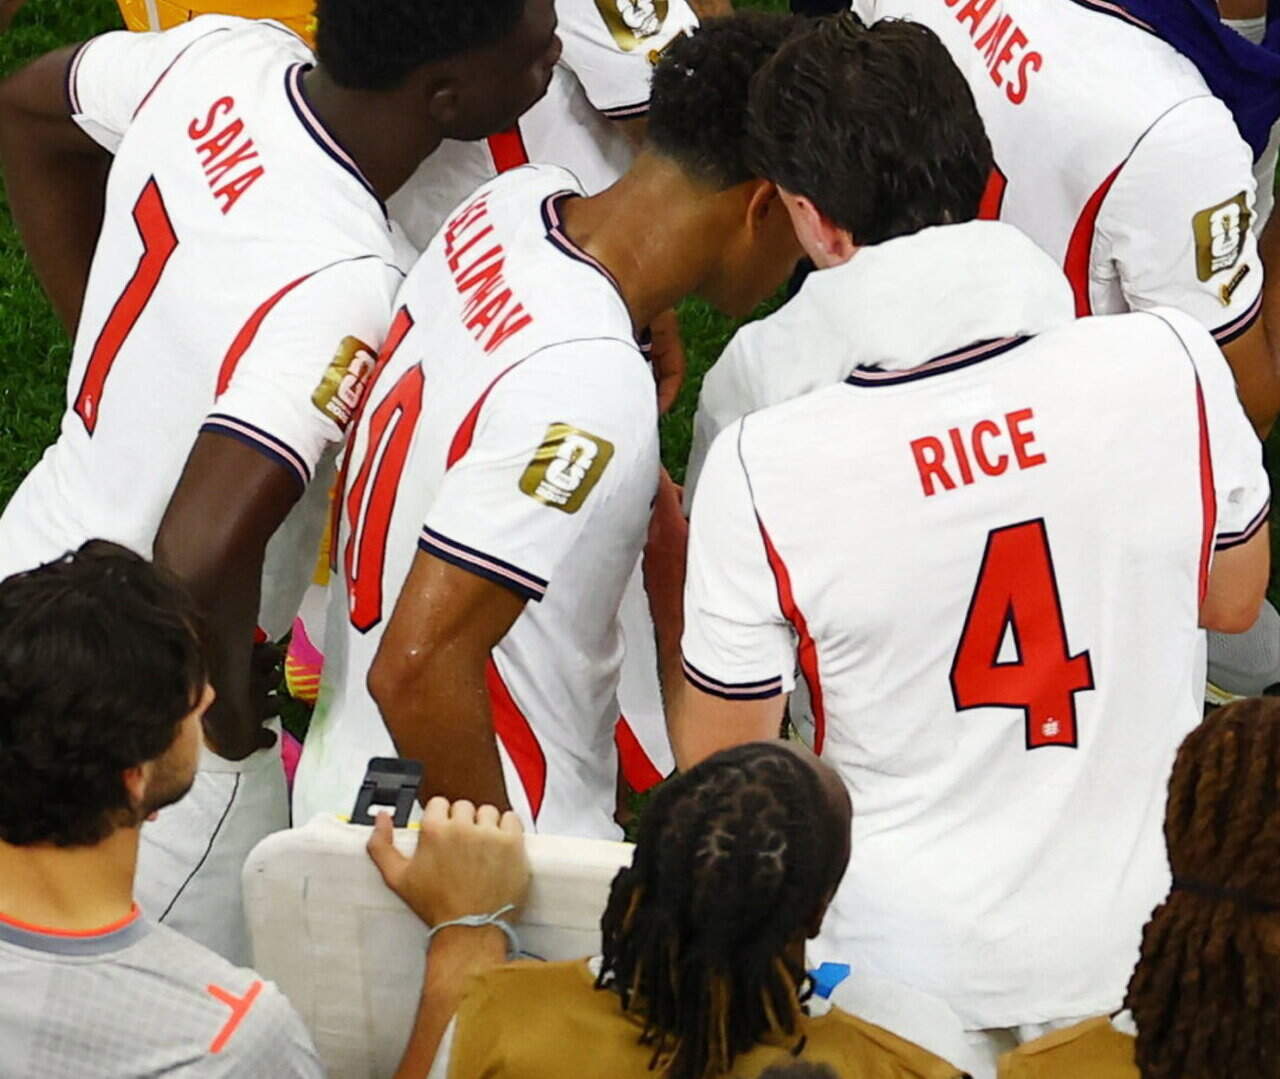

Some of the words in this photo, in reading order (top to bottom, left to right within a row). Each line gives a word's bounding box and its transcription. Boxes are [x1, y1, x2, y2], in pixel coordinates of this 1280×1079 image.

[187, 96, 265, 215] SAKA
[73, 174, 179, 440] 7
[910, 407, 1047, 497] RICE
[948, 516, 1095, 751] 4
